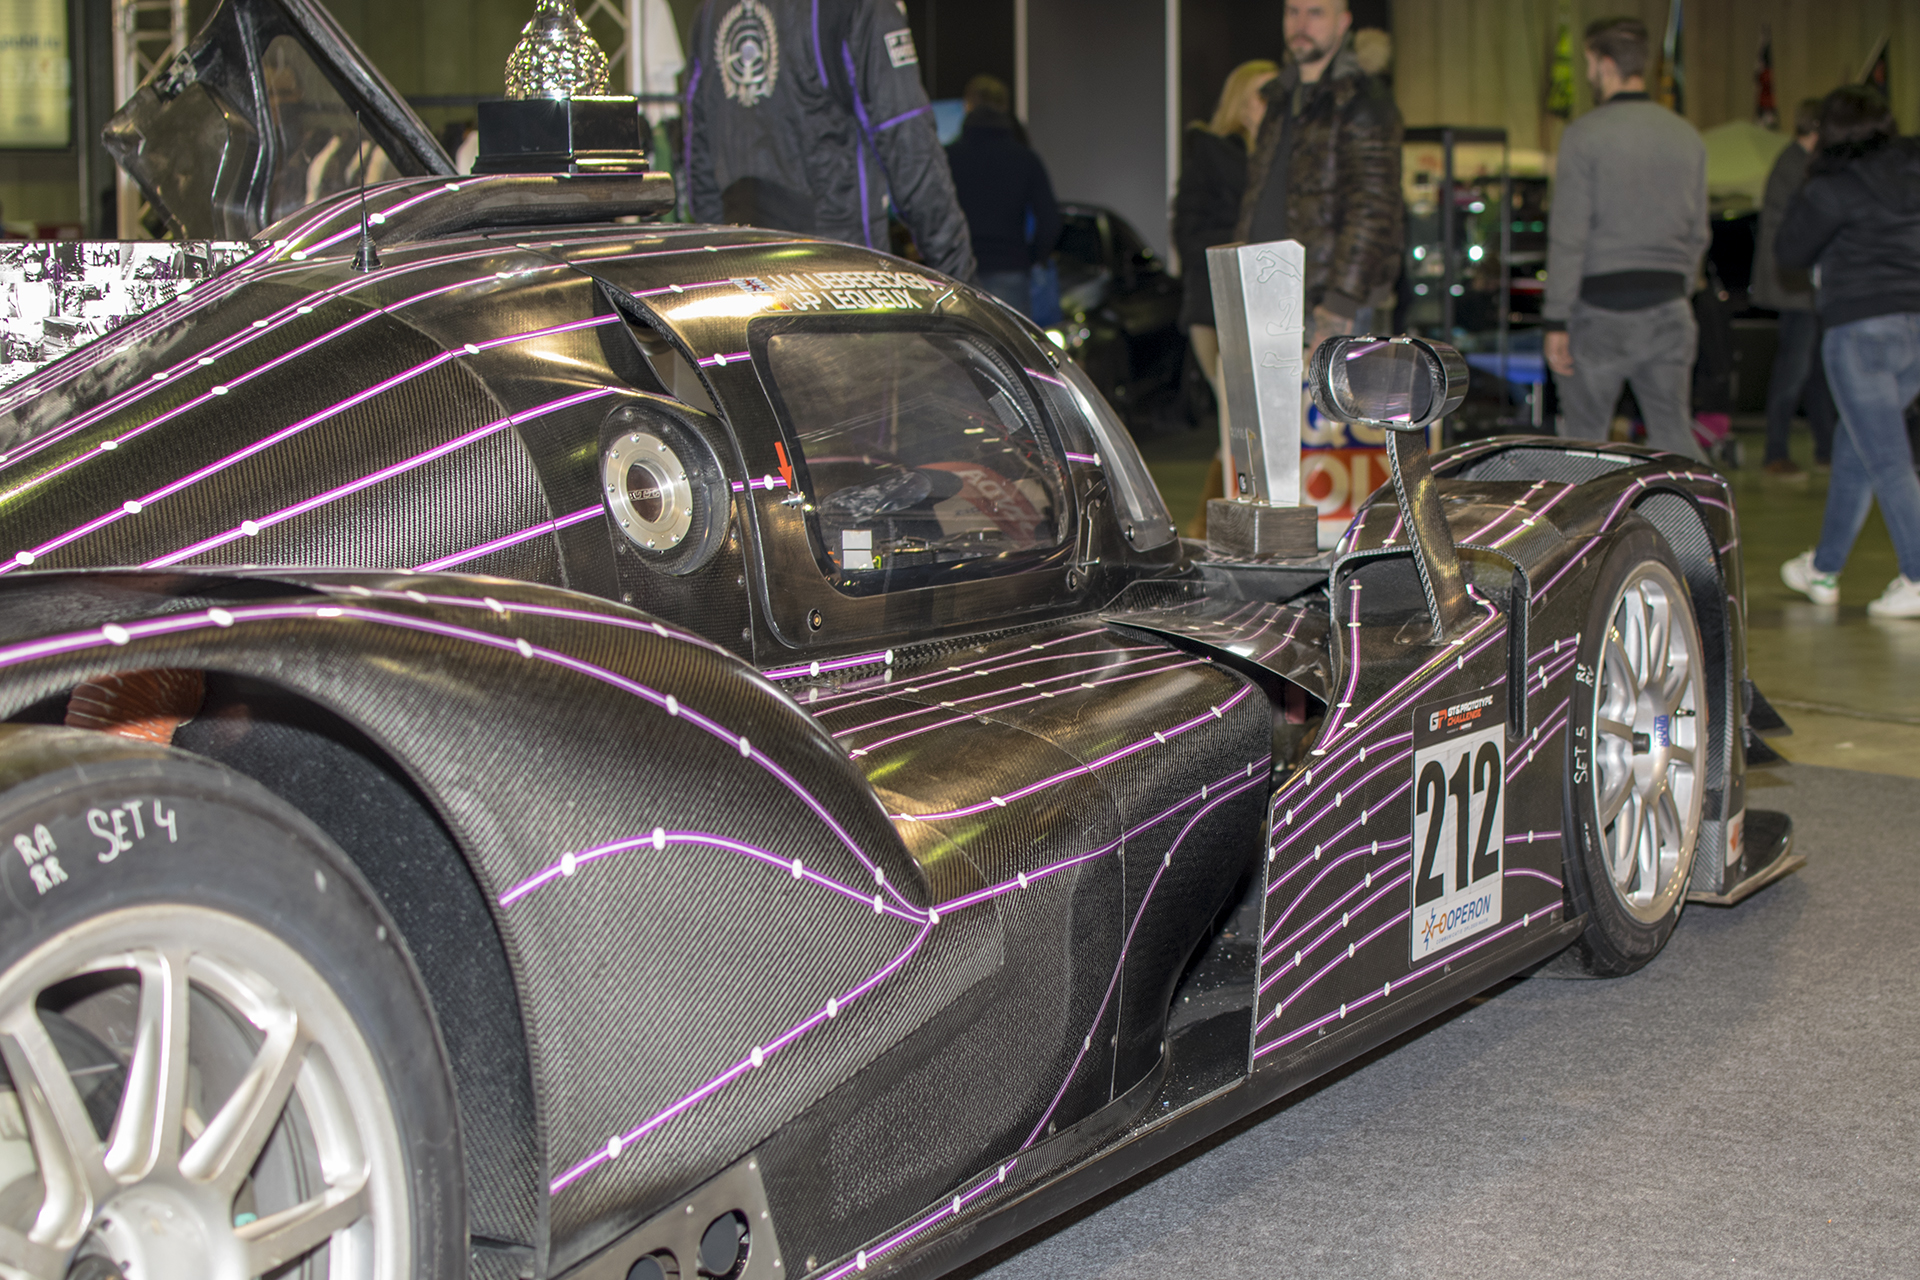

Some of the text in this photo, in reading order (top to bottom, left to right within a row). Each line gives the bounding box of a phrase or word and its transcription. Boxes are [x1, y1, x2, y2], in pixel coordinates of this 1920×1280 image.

[768, 273, 812, 291] J-M
[789, 289, 922, 311] J-P LEQUEUX
[1446, 707, 1483, 727] CHALLENGE
[1574, 725, 1588, 785] SET 5
[13, 823, 57, 867] RA
[86, 798, 178, 863] SET 4
[1415, 741, 1501, 908] 212
[30, 855, 69, 896] RR
